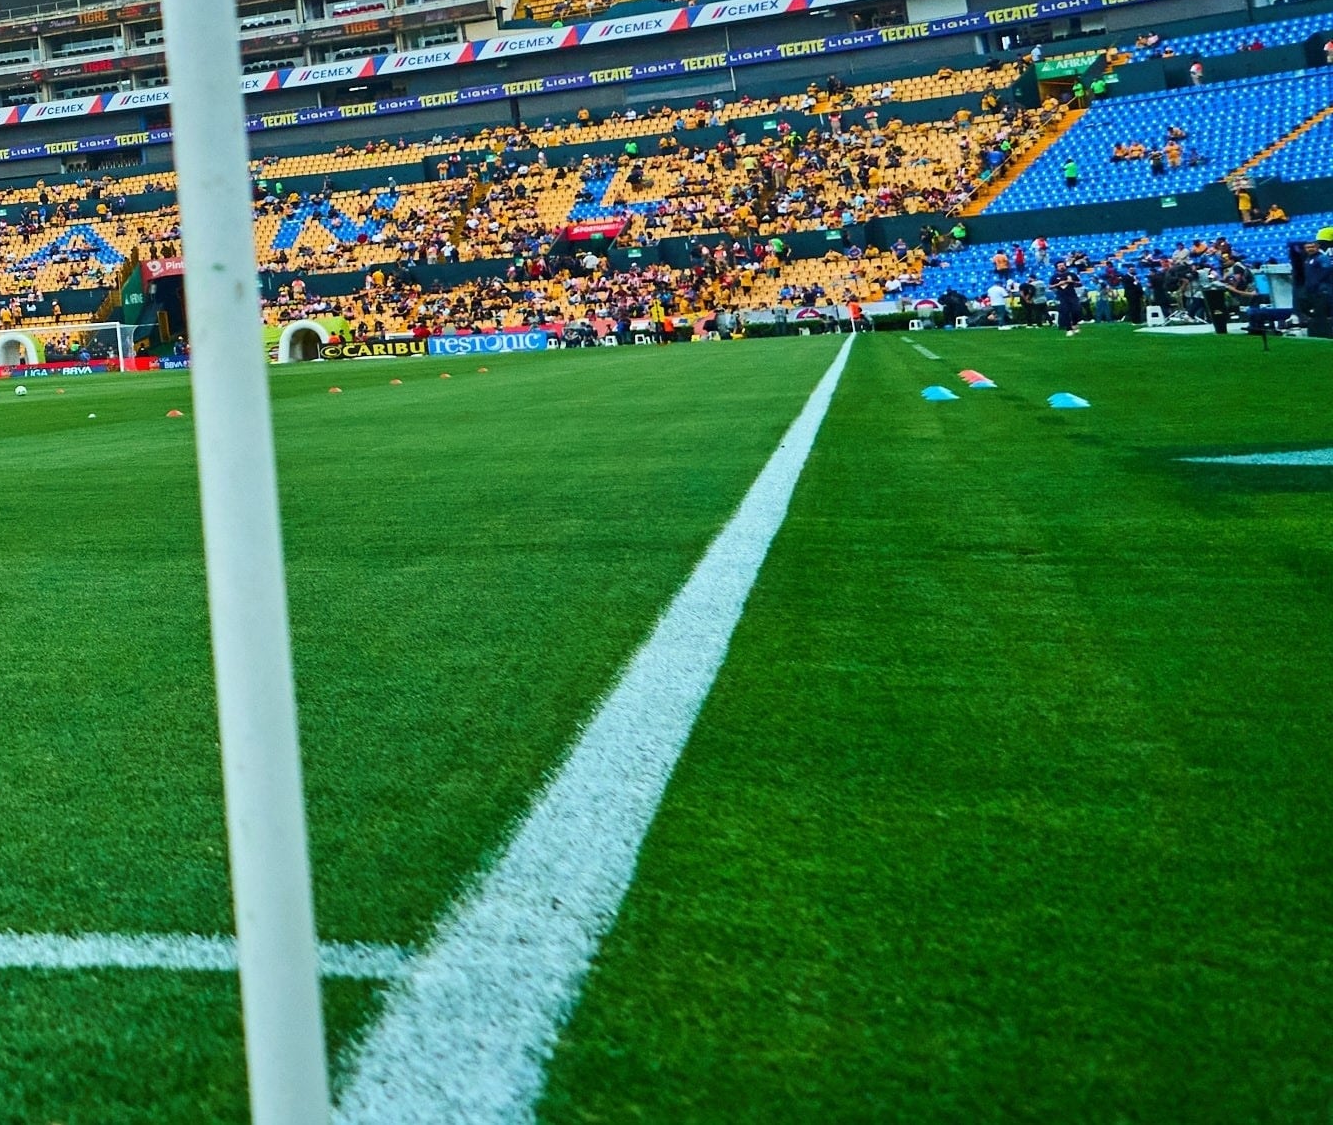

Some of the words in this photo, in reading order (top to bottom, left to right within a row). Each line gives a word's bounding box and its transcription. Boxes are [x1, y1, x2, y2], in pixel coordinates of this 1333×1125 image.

[727, 0, 778, 16] CEMEX
[984, 3, 1038, 24] TECATE
[77, 10, 109, 24] TIGRE
[344, 20, 379, 34] TIGRE
[614, 19, 662, 34] CEMEX
[878, 23, 930, 41] TECATE
[933, 17, 980, 31] LIGHT
[509, 36, 553, 51] CEMEX
[776, 39, 825, 57] TECATE
[828, 34, 874, 47] LIGHT
[408, 52, 451, 66] CEMEX
[681, 54, 727, 71] TECATE
[729, 49, 773, 62] LIGHT
[312, 66, 353, 80] CEMEX
[589, 66, 633, 84] TECATE
[635, 63, 676, 75] LIGHT
[502, 80, 544, 95] TECATE
[546, 76, 585, 87] LIGHT
[132, 92, 169, 103] CEMEX
[418, 92, 458, 107] TECATE
[460, 88, 498, 99] LIGHT
[47, 103, 83, 115] CEMEX
[338, 102, 377, 117] TECATE
[379, 100, 414, 110] LIGHT
[260, 113, 298, 127] TECATE
[300, 110, 334, 120] LIGHT
[44, 141, 79, 154] TECATE
[80, 139, 111, 148] LIGHT
[114, 132, 149, 147] TECATE
[151, 131, 174, 140] LIGH
[343, 341, 425, 356] CARIBU
[63, 366, 92, 375] BBVA
[164, 361, 183, 369] BBVA
